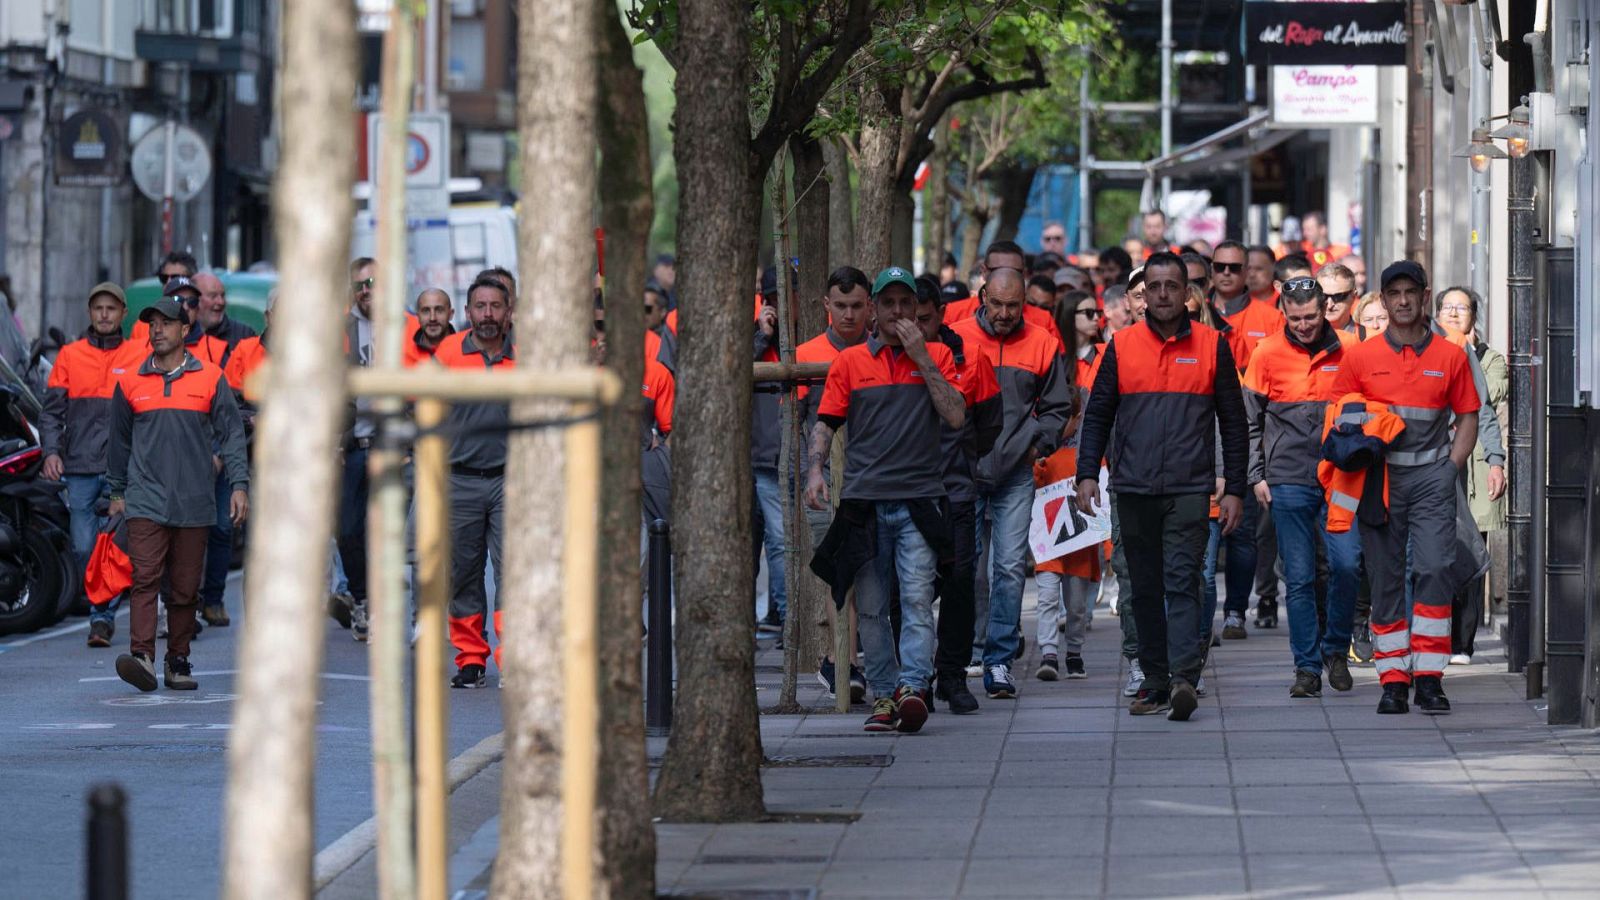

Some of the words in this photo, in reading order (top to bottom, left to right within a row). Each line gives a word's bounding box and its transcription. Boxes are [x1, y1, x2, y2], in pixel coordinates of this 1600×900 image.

[1259, 24, 1284, 44] del
[1323, 25, 1343, 44] al
[1341, 21, 1408, 46] Amarillo
